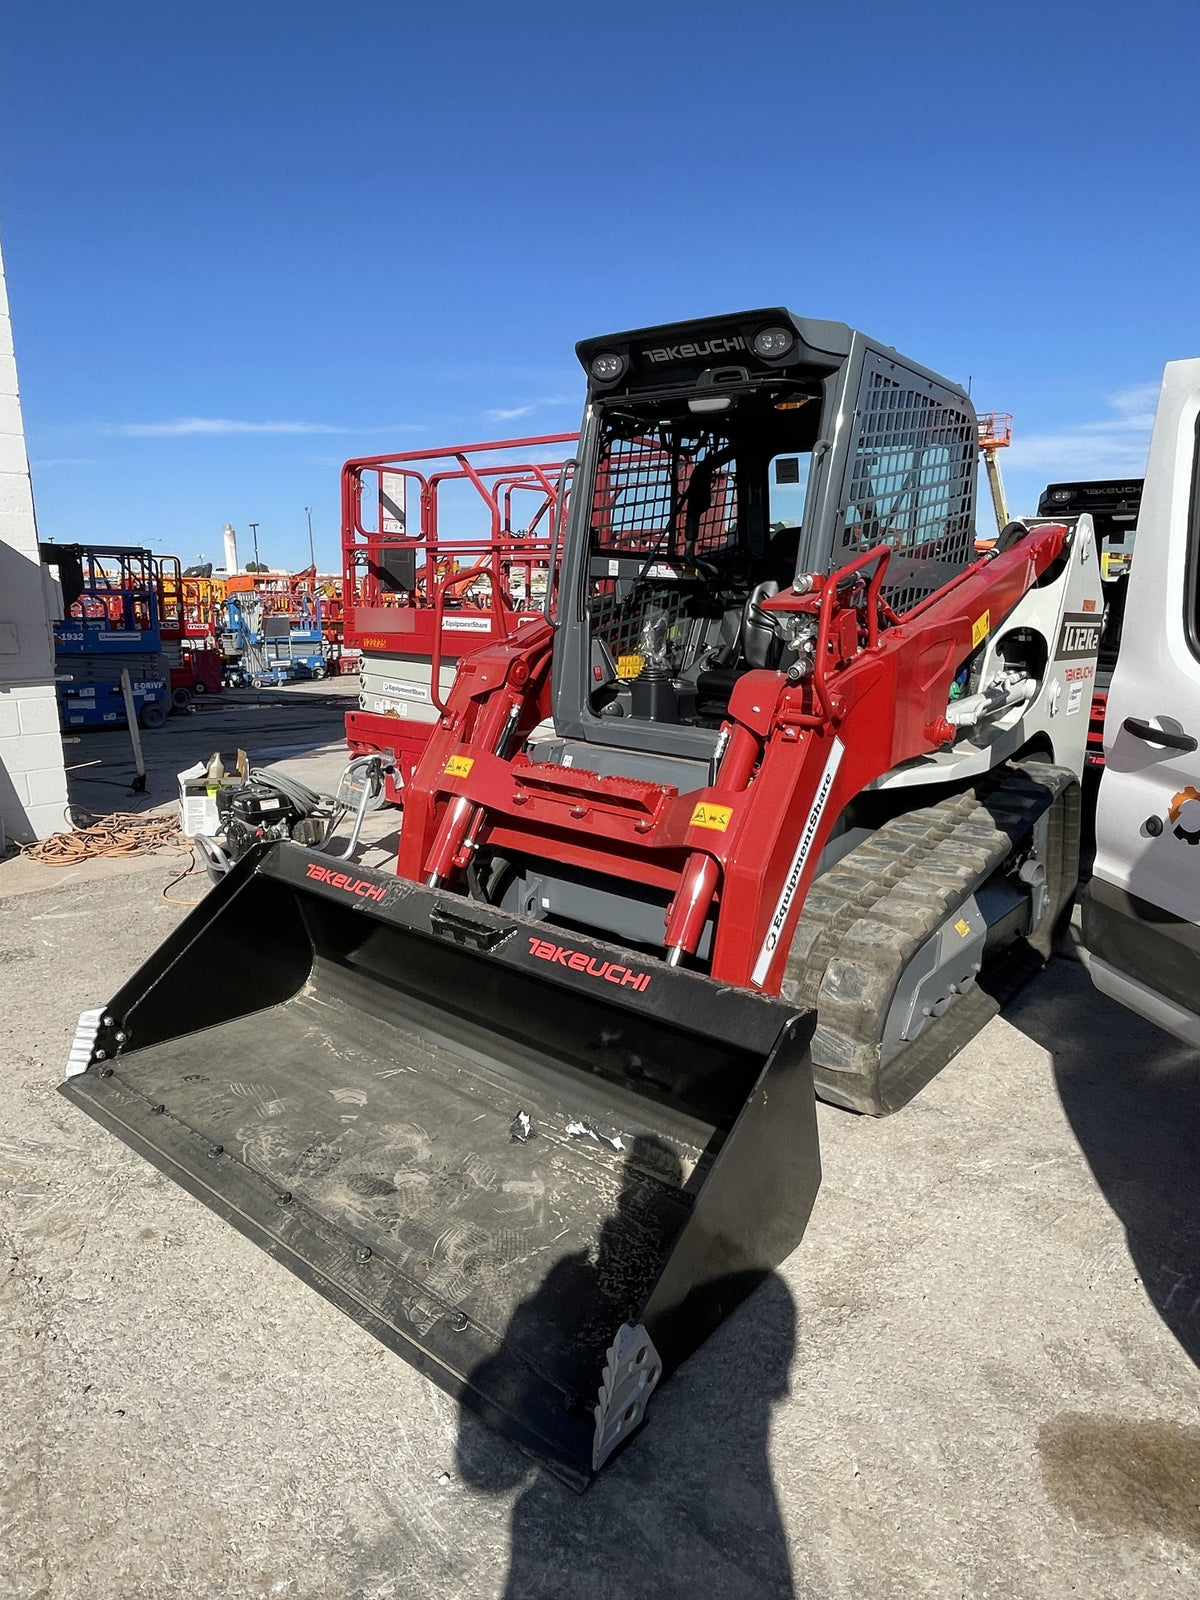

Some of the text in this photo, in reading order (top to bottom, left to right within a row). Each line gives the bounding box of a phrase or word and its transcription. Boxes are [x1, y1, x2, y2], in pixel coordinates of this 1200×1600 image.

[1083, 486, 1142, 495] TAKEUCH
[1062, 622, 1101, 652] TL12R2
[773, 772, 833, 931] EquipmentShare
